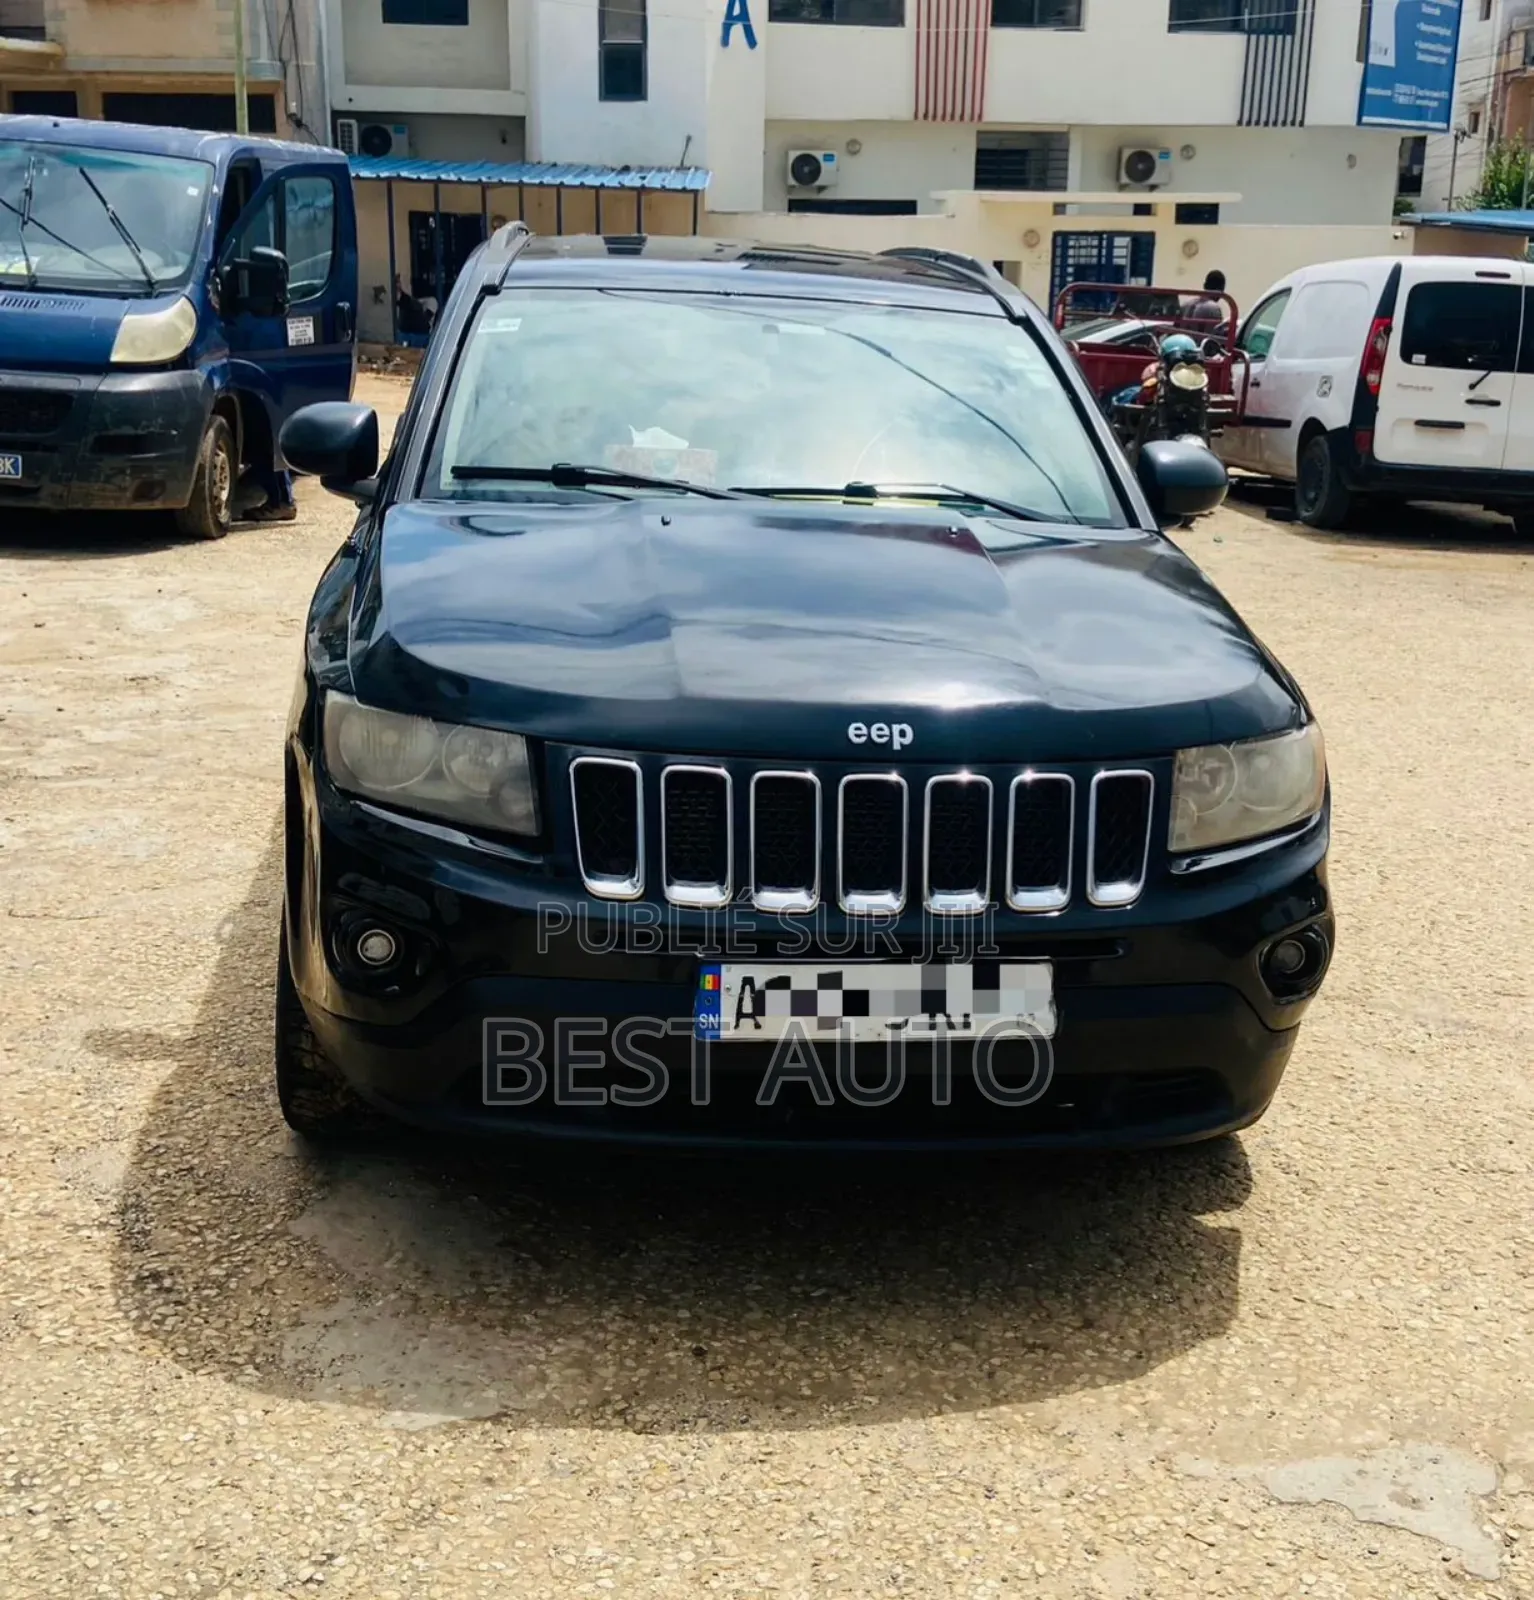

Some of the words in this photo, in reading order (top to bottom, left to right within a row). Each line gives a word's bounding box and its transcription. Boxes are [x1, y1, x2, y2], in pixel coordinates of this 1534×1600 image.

[721, 0, 758, 50] A
[848, 722, 914, 750] eep
[699, 1013, 719, 1030] SN
